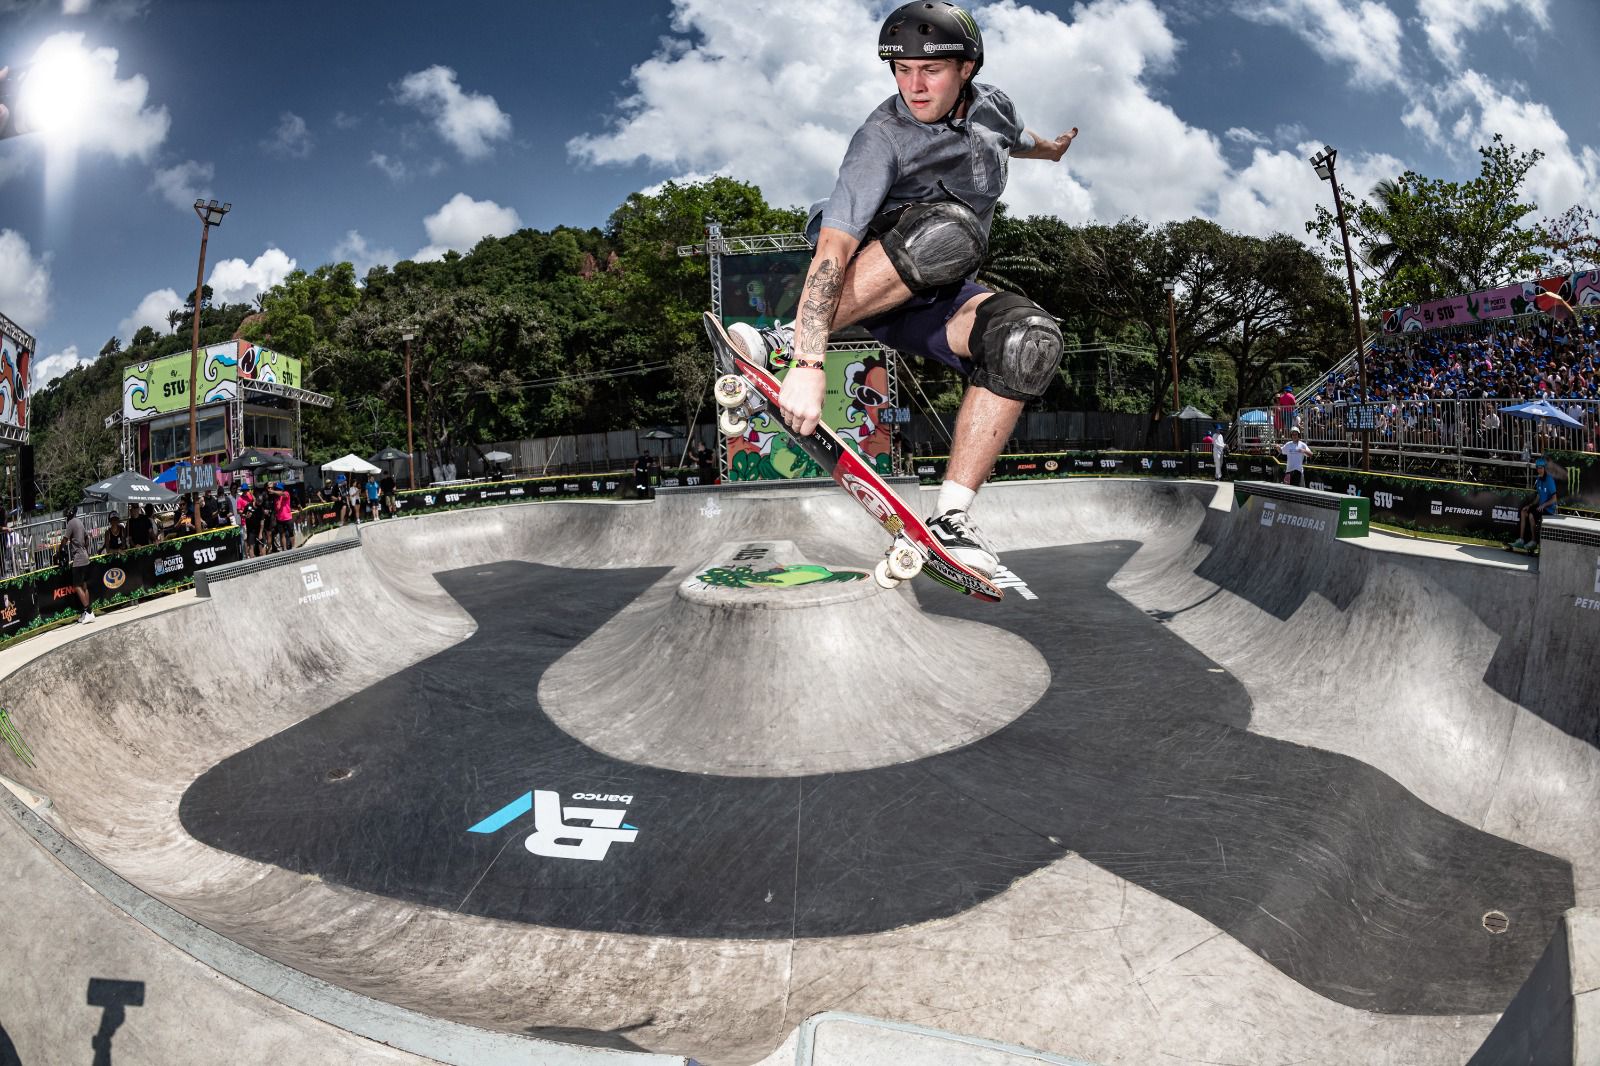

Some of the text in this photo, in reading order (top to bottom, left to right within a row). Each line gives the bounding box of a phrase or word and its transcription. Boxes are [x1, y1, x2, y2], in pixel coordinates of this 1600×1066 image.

[1437, 306, 1455, 321] STU
[283, 371, 294, 386] STU
[163, 379, 186, 398] STU
[1162, 460, 1176, 468] STU
[195, 464, 214, 488] 20:00
[130, 484, 151, 492] STU
[606, 482, 615, 490] STU
[445, 493, 460, 502] STU
[1373, 491, 1393, 509] STU
[1444, 506, 1483, 517] PETROBRAS
[1491, 509, 1520, 522] BRASIL
[1276, 513, 1326, 531] PETROBRAS
[163, 557, 183, 567] PORTO
[193, 547, 217, 564] STU
[1, 606, 17, 622] Tiger
[571, 792, 634, 805] banco
